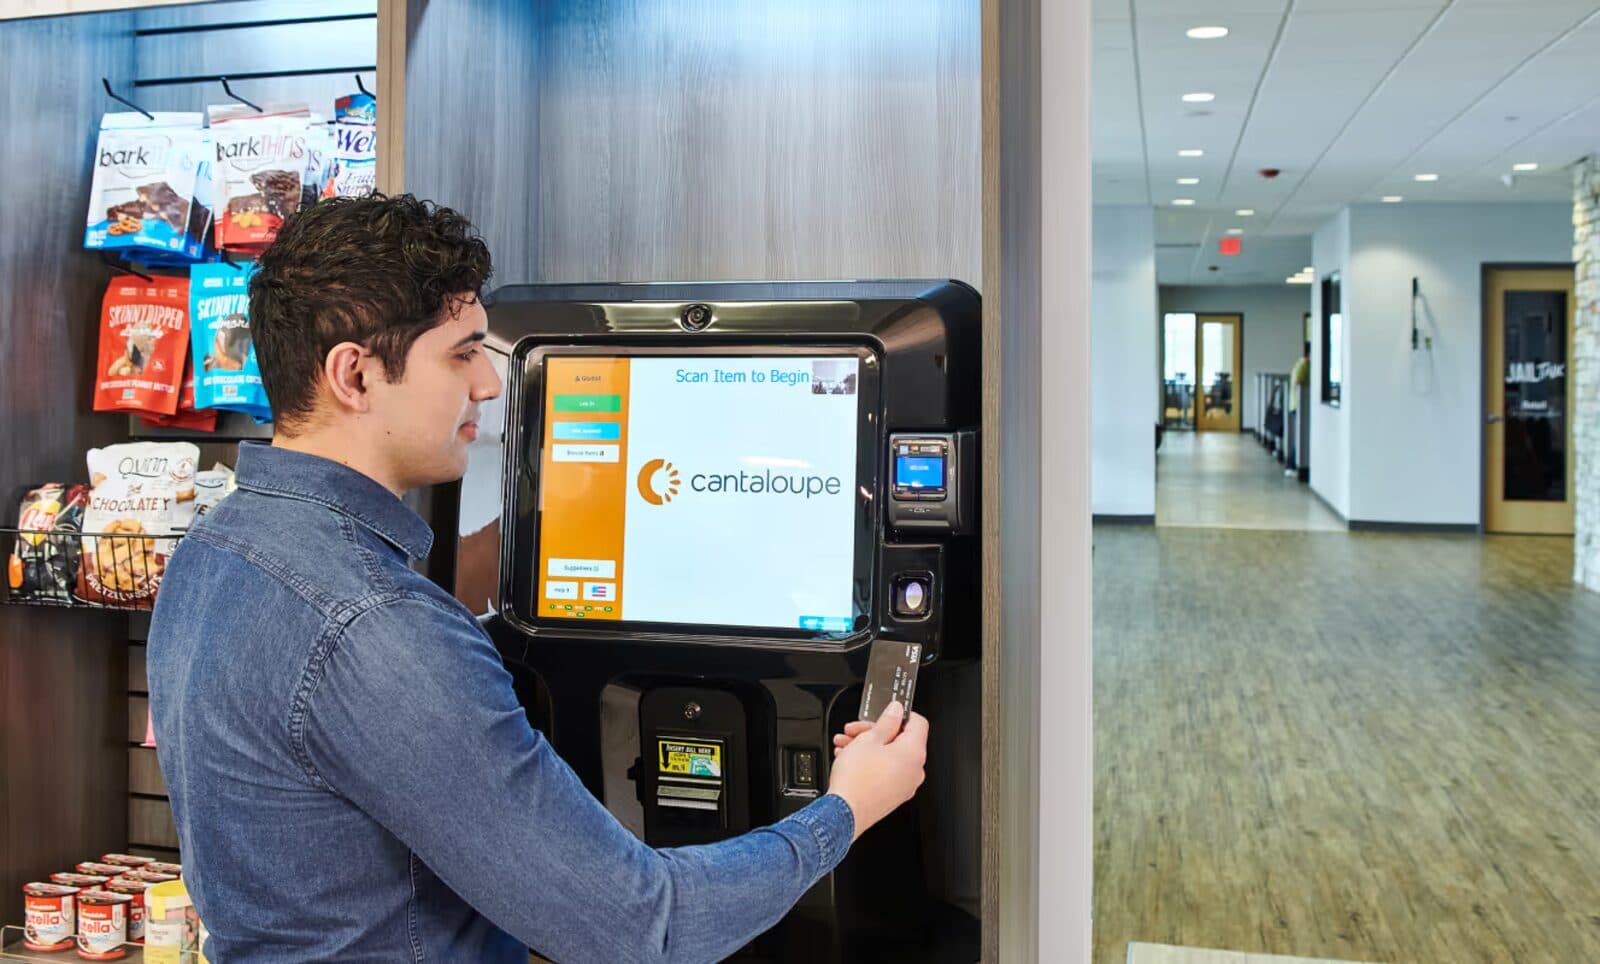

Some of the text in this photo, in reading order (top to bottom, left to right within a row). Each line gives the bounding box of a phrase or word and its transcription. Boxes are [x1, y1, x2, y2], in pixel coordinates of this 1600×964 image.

[676, 369, 809, 386] Scan Item to Begin
[691, 468, 841, 499] cantaloupe
